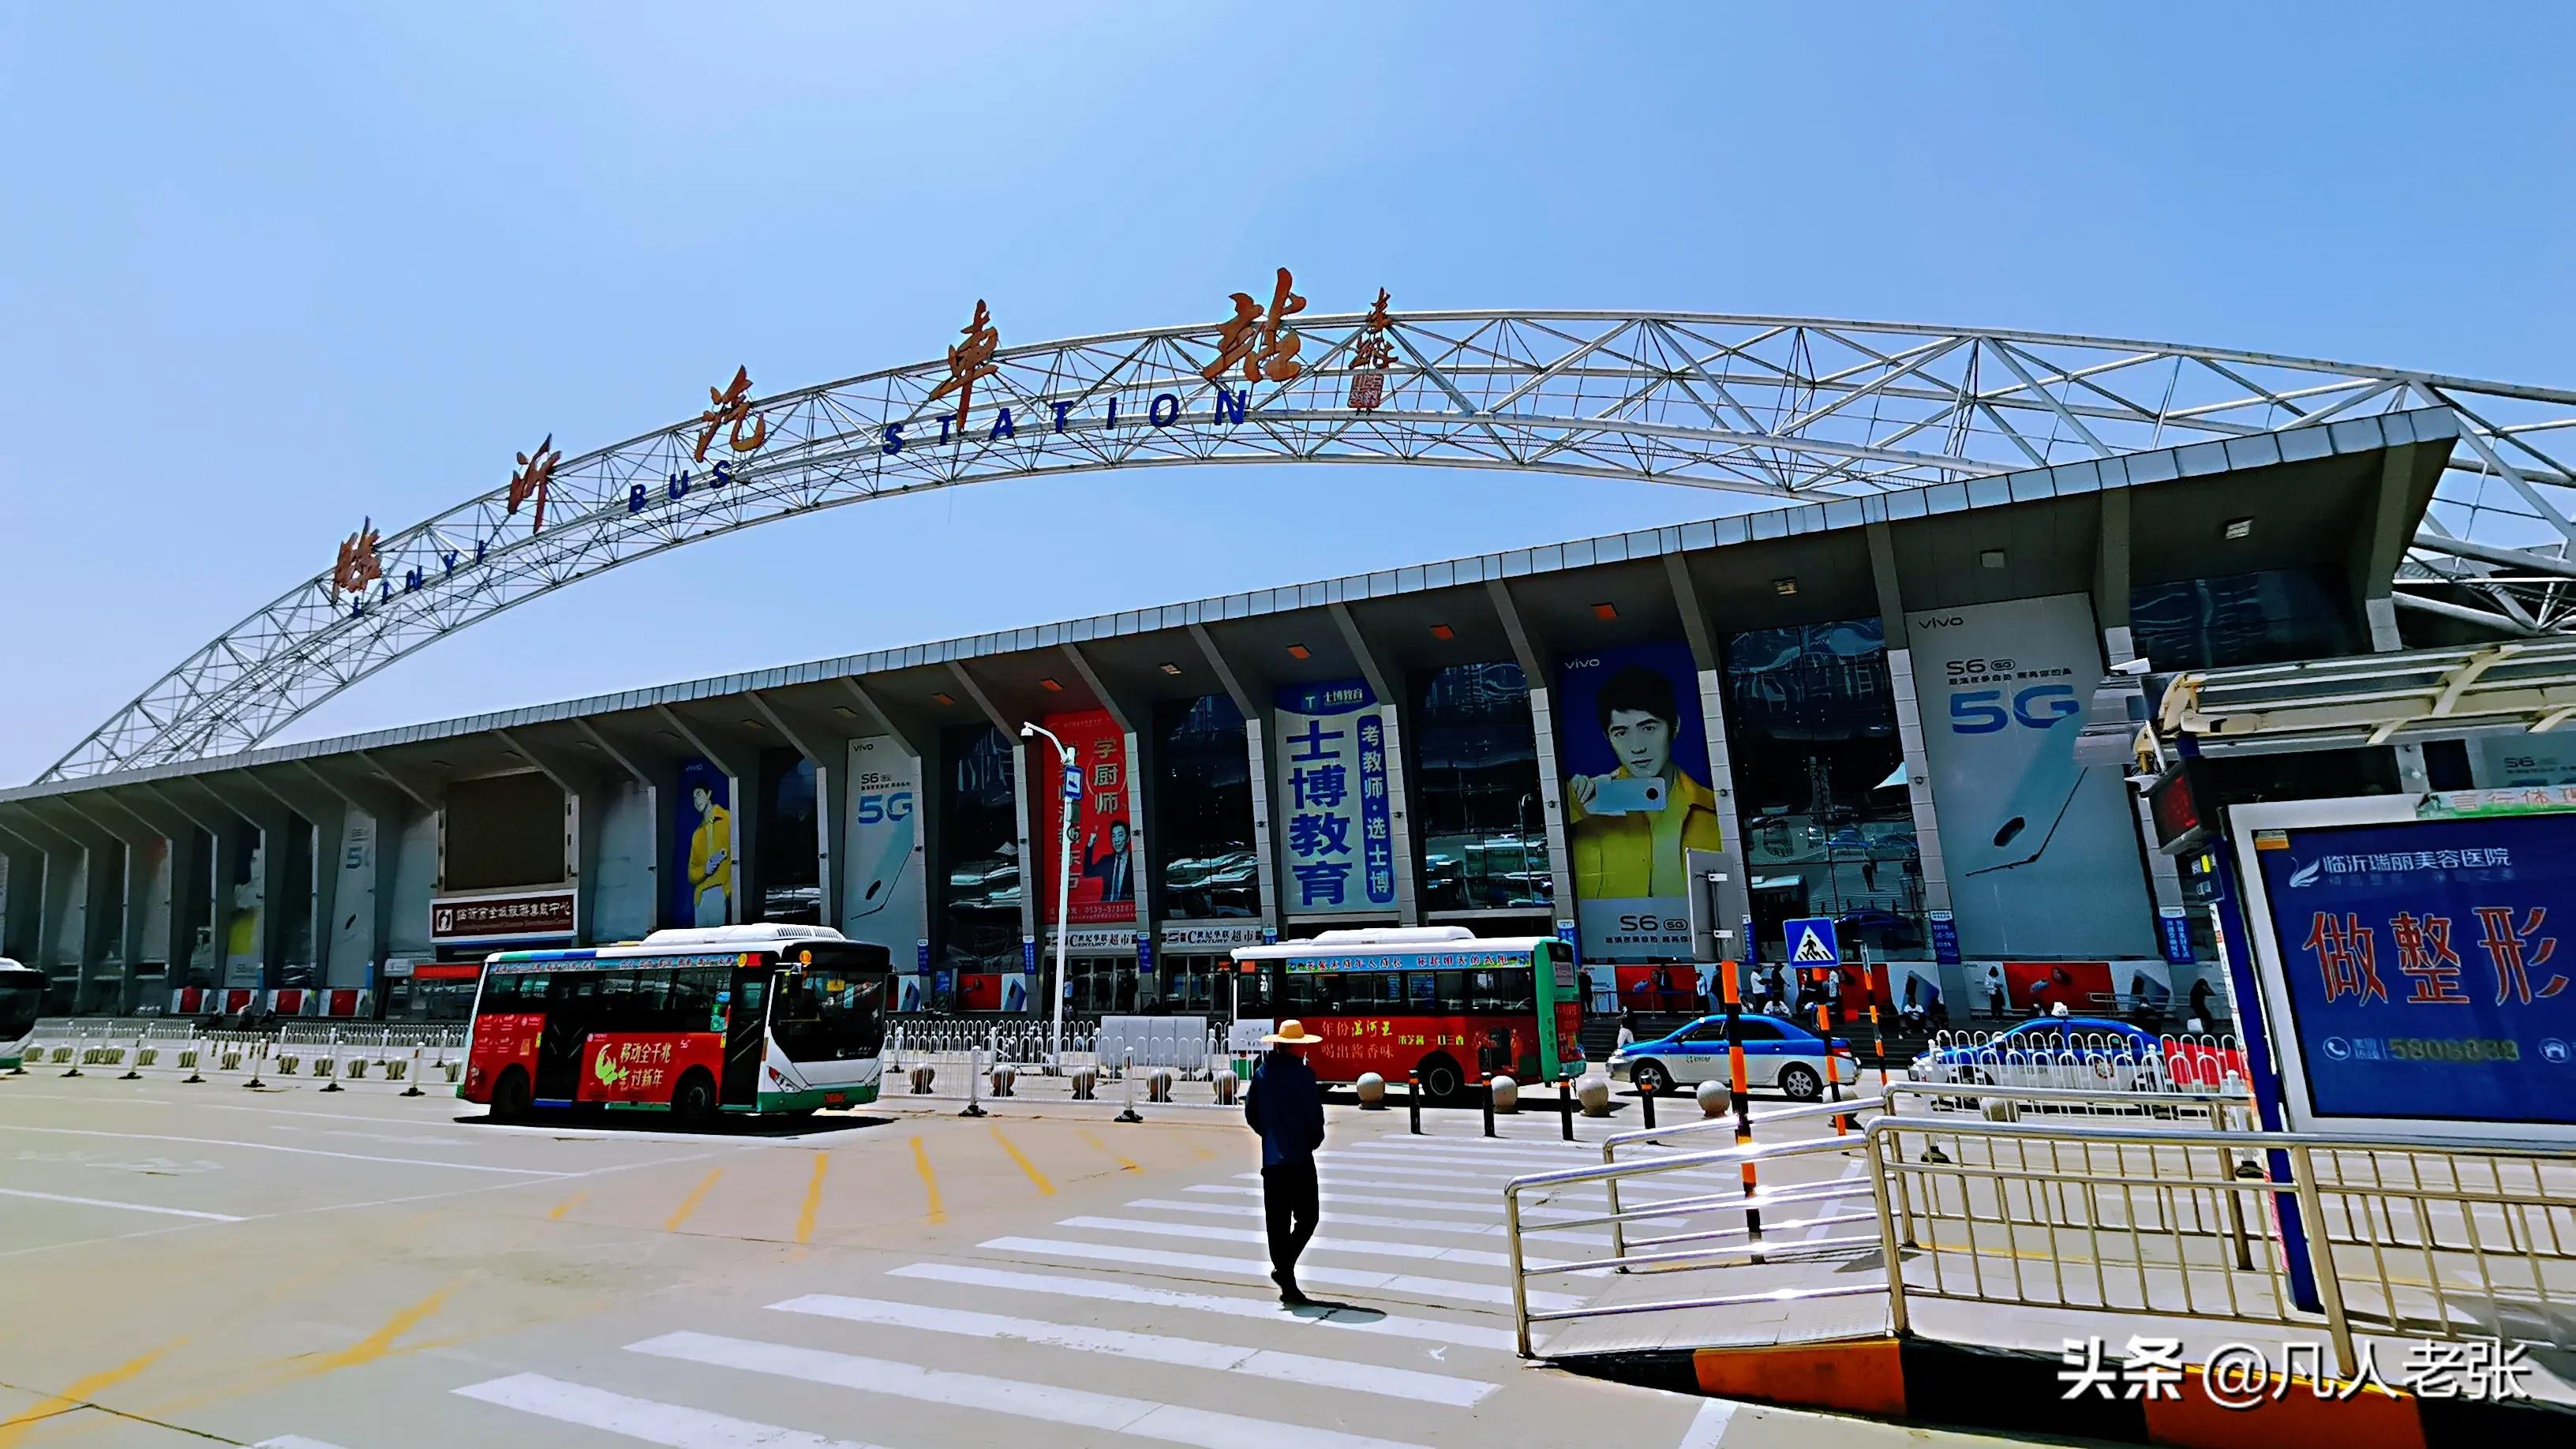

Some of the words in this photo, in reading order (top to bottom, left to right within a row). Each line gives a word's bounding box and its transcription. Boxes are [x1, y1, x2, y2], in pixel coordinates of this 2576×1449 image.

[352, 539, 485, 618] LINYI
[628, 460, 732, 512] BUS
[881, 388, 1247, 455] STATION
[1919, 616, 1964, 629] vivo
[1564, 658, 1601, 669] vivo
[1945, 659, 1986, 676] S6
[1949, 684, 2080, 734] 5G
[1093, 736, 1119, 814] 学厨师
[2504, 756, 2536, 769] S6
[861, 773, 879, 784] S6
[858, 792, 913, 824] 5G
[1286, 719, 1353, 907] 士博教育
[2323, 847, 2513, 874] 临沂瑞丽美容医院
[1619, 915, 1659, 931] S6
[2302, 906, 2570, 1006] 做整形
